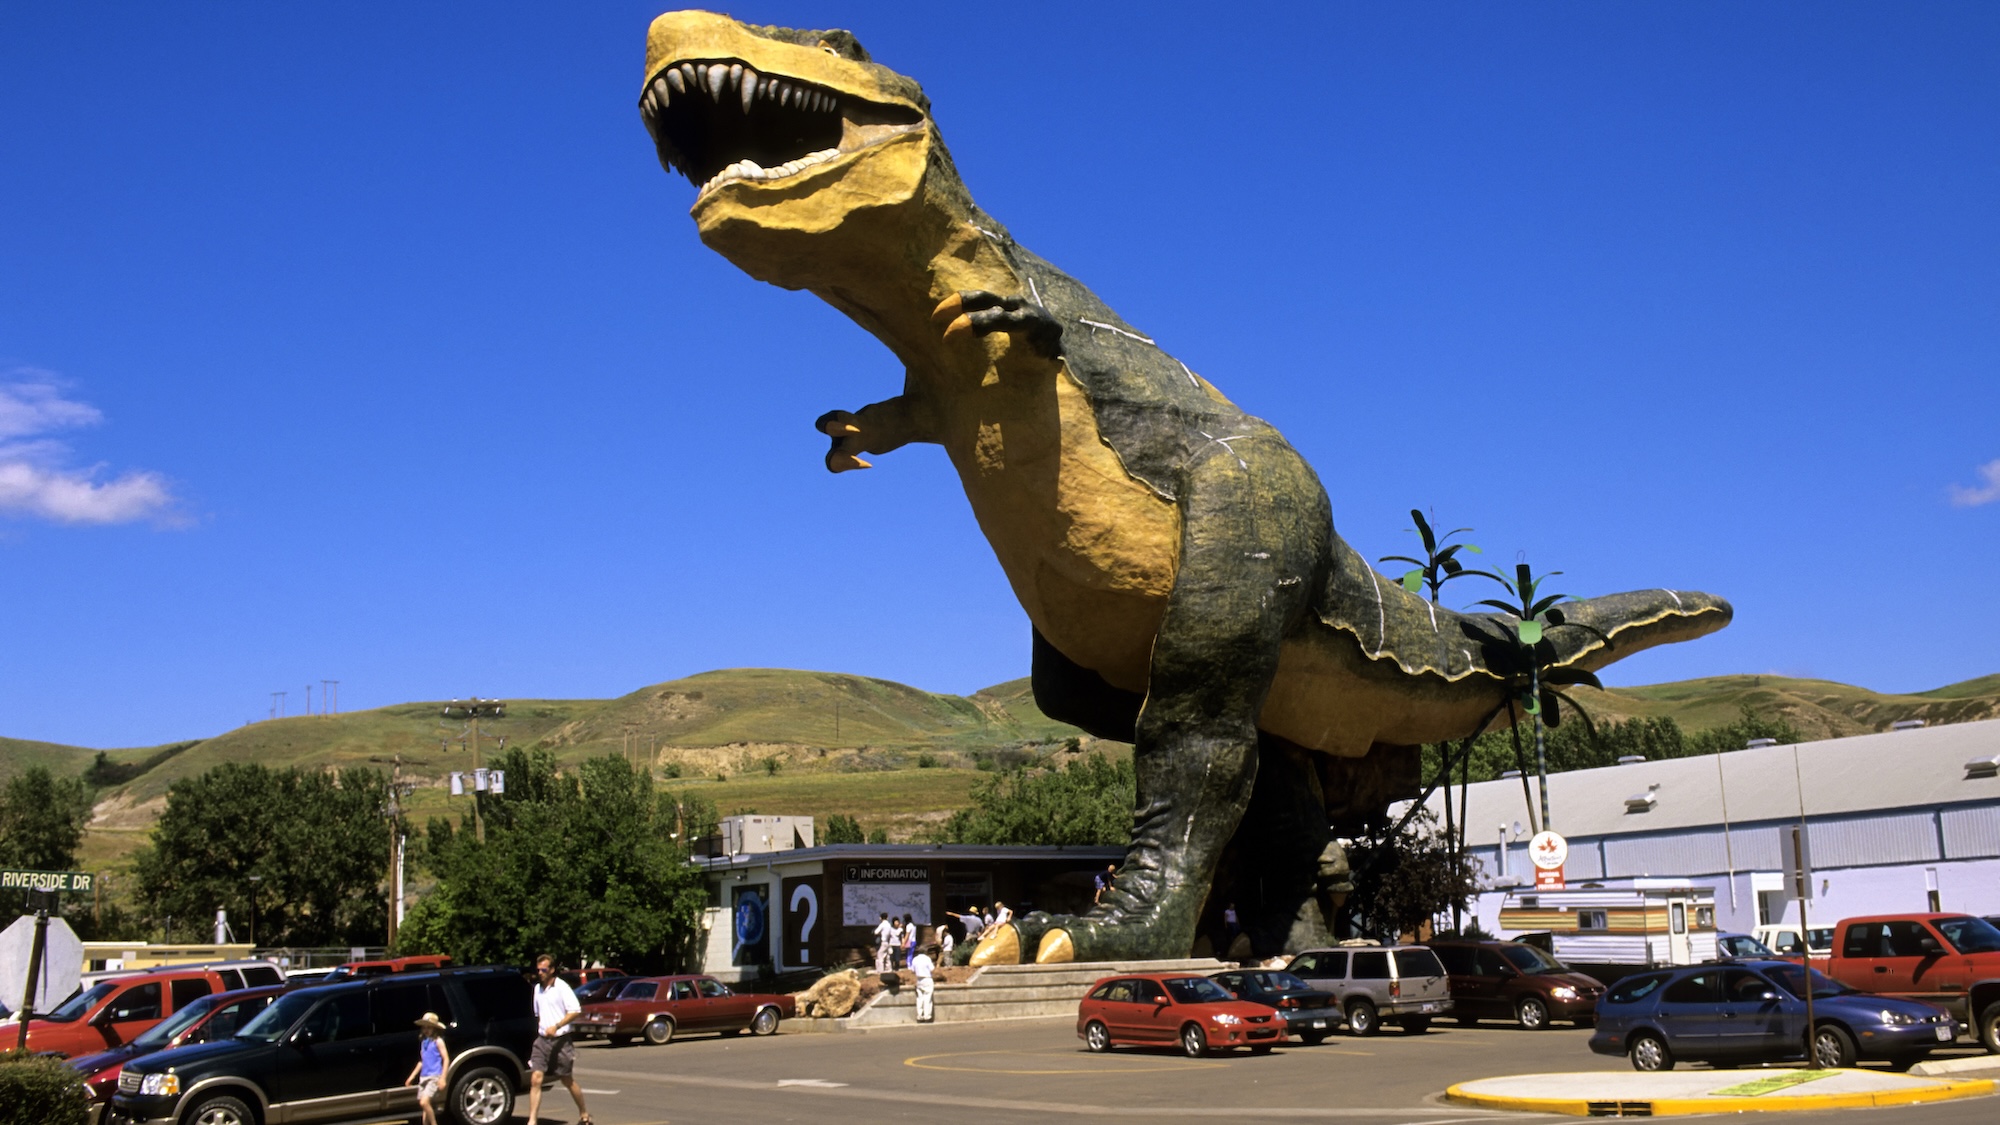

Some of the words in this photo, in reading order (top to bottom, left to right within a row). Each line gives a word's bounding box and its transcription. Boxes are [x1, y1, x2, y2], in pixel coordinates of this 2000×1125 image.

[861, 868, 927, 879] INFORMATION
[2, 872, 68, 889] RIVERSIDE
[72, 874, 91, 890] DR
